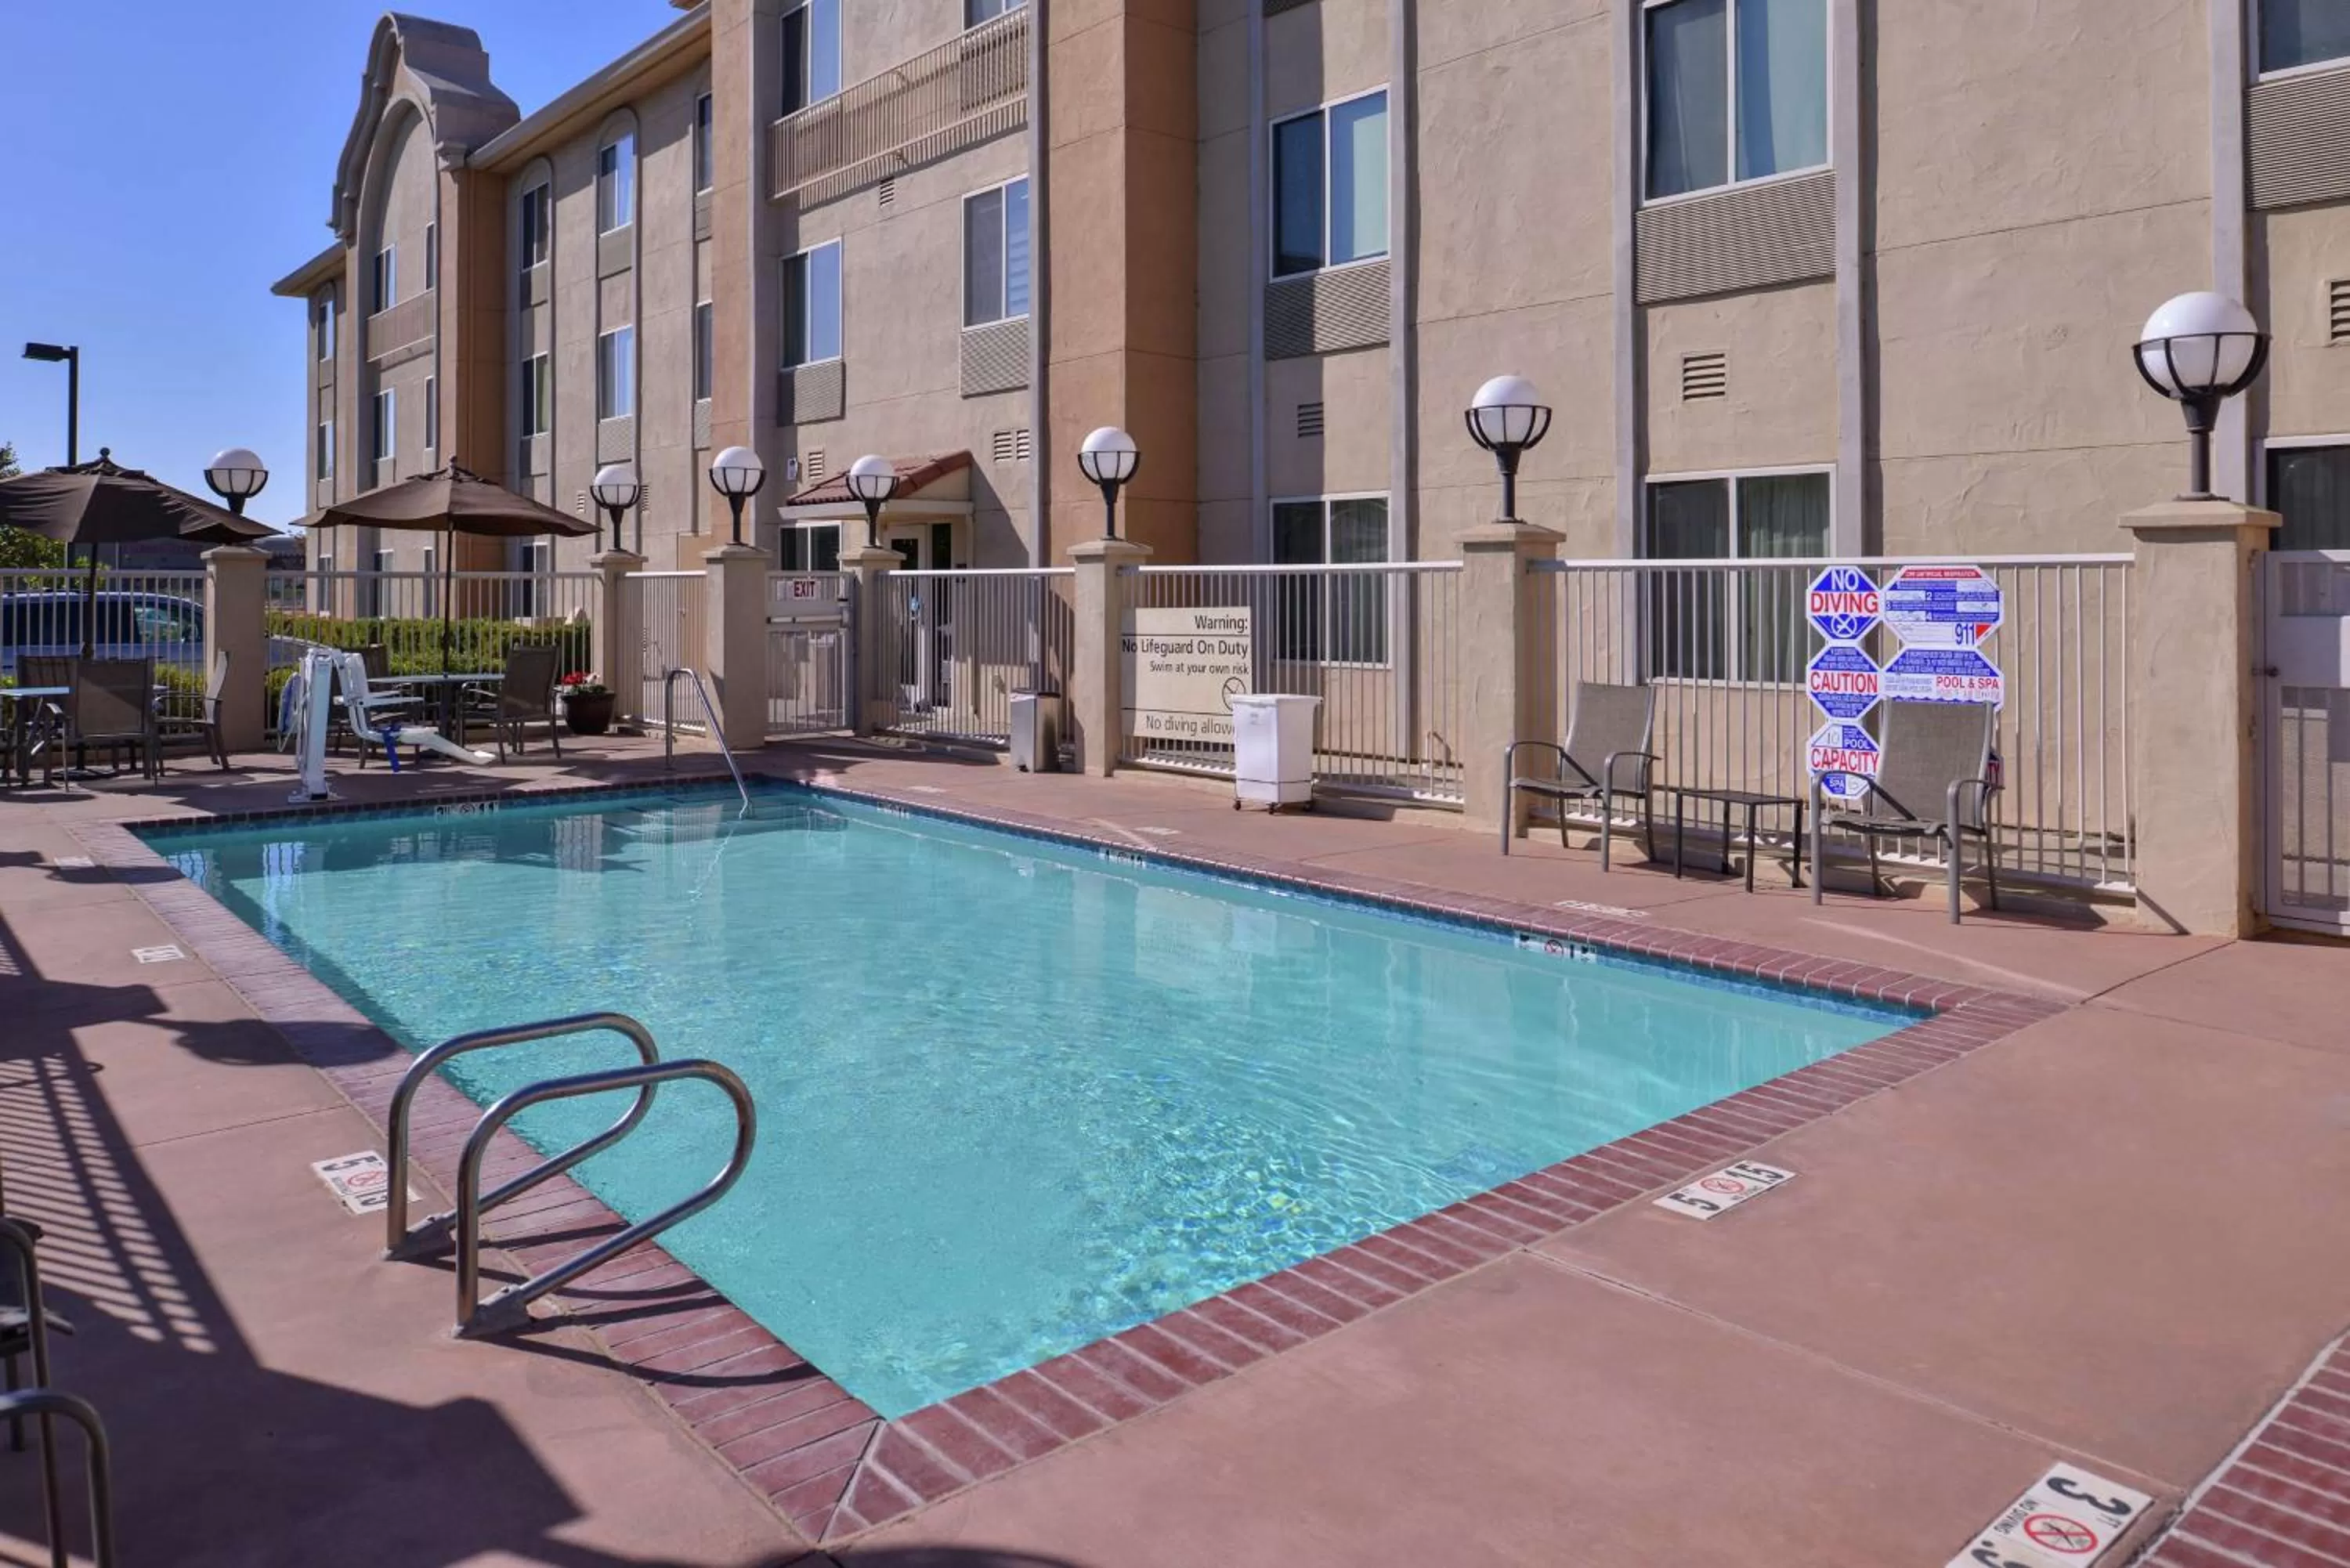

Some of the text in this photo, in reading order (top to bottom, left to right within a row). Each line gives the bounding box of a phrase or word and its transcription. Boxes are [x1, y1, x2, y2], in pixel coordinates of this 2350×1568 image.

[794, 580, 815, 597] EXIT
[1831, 569, 1858, 591] NO
[1811, 593, 1878, 613] DIVING
[1195, 615, 1249, 633] Warning:
[1955, 623, 1975, 645] 911
[1123, 639, 1249, 659] No Lifeguard On Duty
[1150, 660, 1173, 673] Swim
[1176, 663, 1184, 673] at
[1187, 665, 1206, 675] your
[1209, 665, 1231, 674] own
[1811, 671, 1877, 692] CAUTION
[1936, 676, 1965, 688] POOL
[1968, 677, 1975, 688] &
[1978, 677, 1999, 690] SPA
[1146, 716, 1161, 729] No
[1165, 717, 1197, 736] diving
[1201, 717, 1235, 735] allow
[1845, 739, 1871, 750] POOL
[1811, 749, 1879, 773] CAPACITY
[1668, 1192, 1721, 1212] 5
[2046, 1476, 2132, 1516] 3
